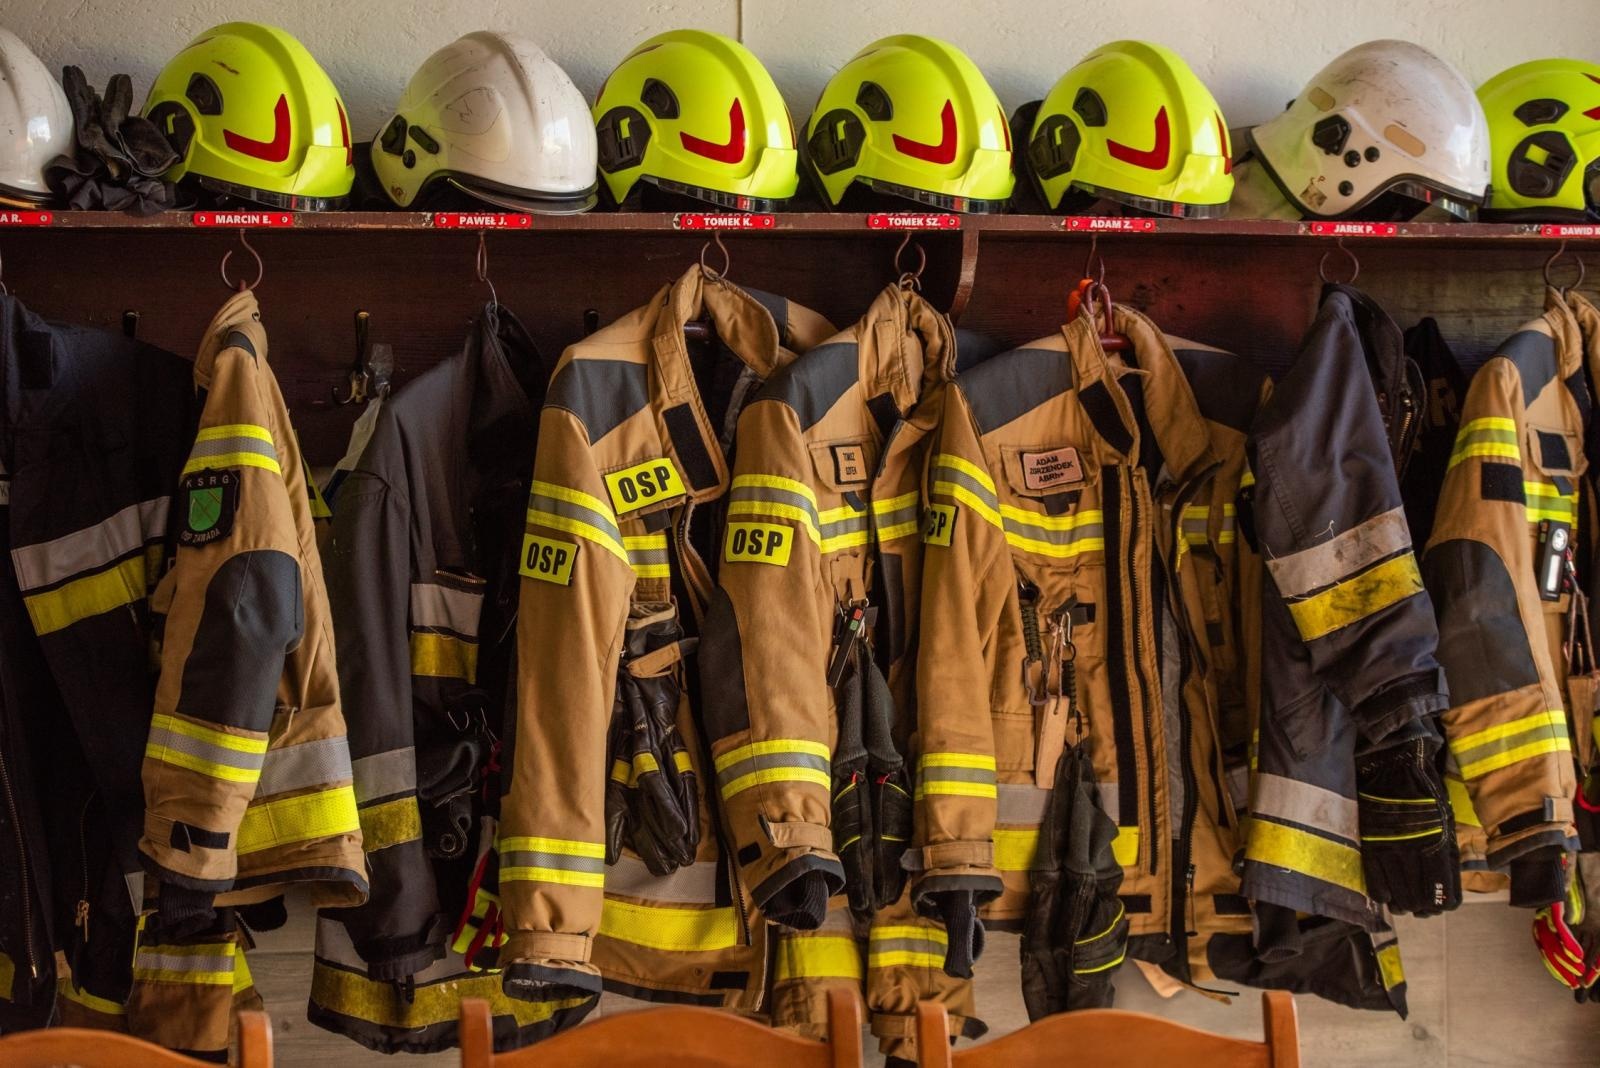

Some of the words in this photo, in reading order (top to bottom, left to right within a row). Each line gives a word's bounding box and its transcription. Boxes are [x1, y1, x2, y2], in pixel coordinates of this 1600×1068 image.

[11, 213, 22, 223] R.
[215, 215, 260, 224] MARCIN
[262, 215, 272, 224] E.
[459, 216, 496, 225] PAWEŁ
[498, 216, 508, 225] J.
[703, 217, 740, 226] TOMEK
[743, 217, 753, 226] K.
[887, 217, 925, 226] TOMEK
[926, 217, 941, 226] SZ.
[1090, 220, 1122, 229] ADAM
[1123, 220, 1133, 229] Z.
[1334, 224, 1365, 233] JAREK
[1365, 225, 1376, 234] P.
[1560, 227, 1593, 235] DAWID
[1036, 455, 1059, 466] ADAM
[617, 465, 671, 503] OSP
[927, 509, 947, 537] SP
[732, 527, 784, 557] OSP
[526, 541, 567, 576] OSP
